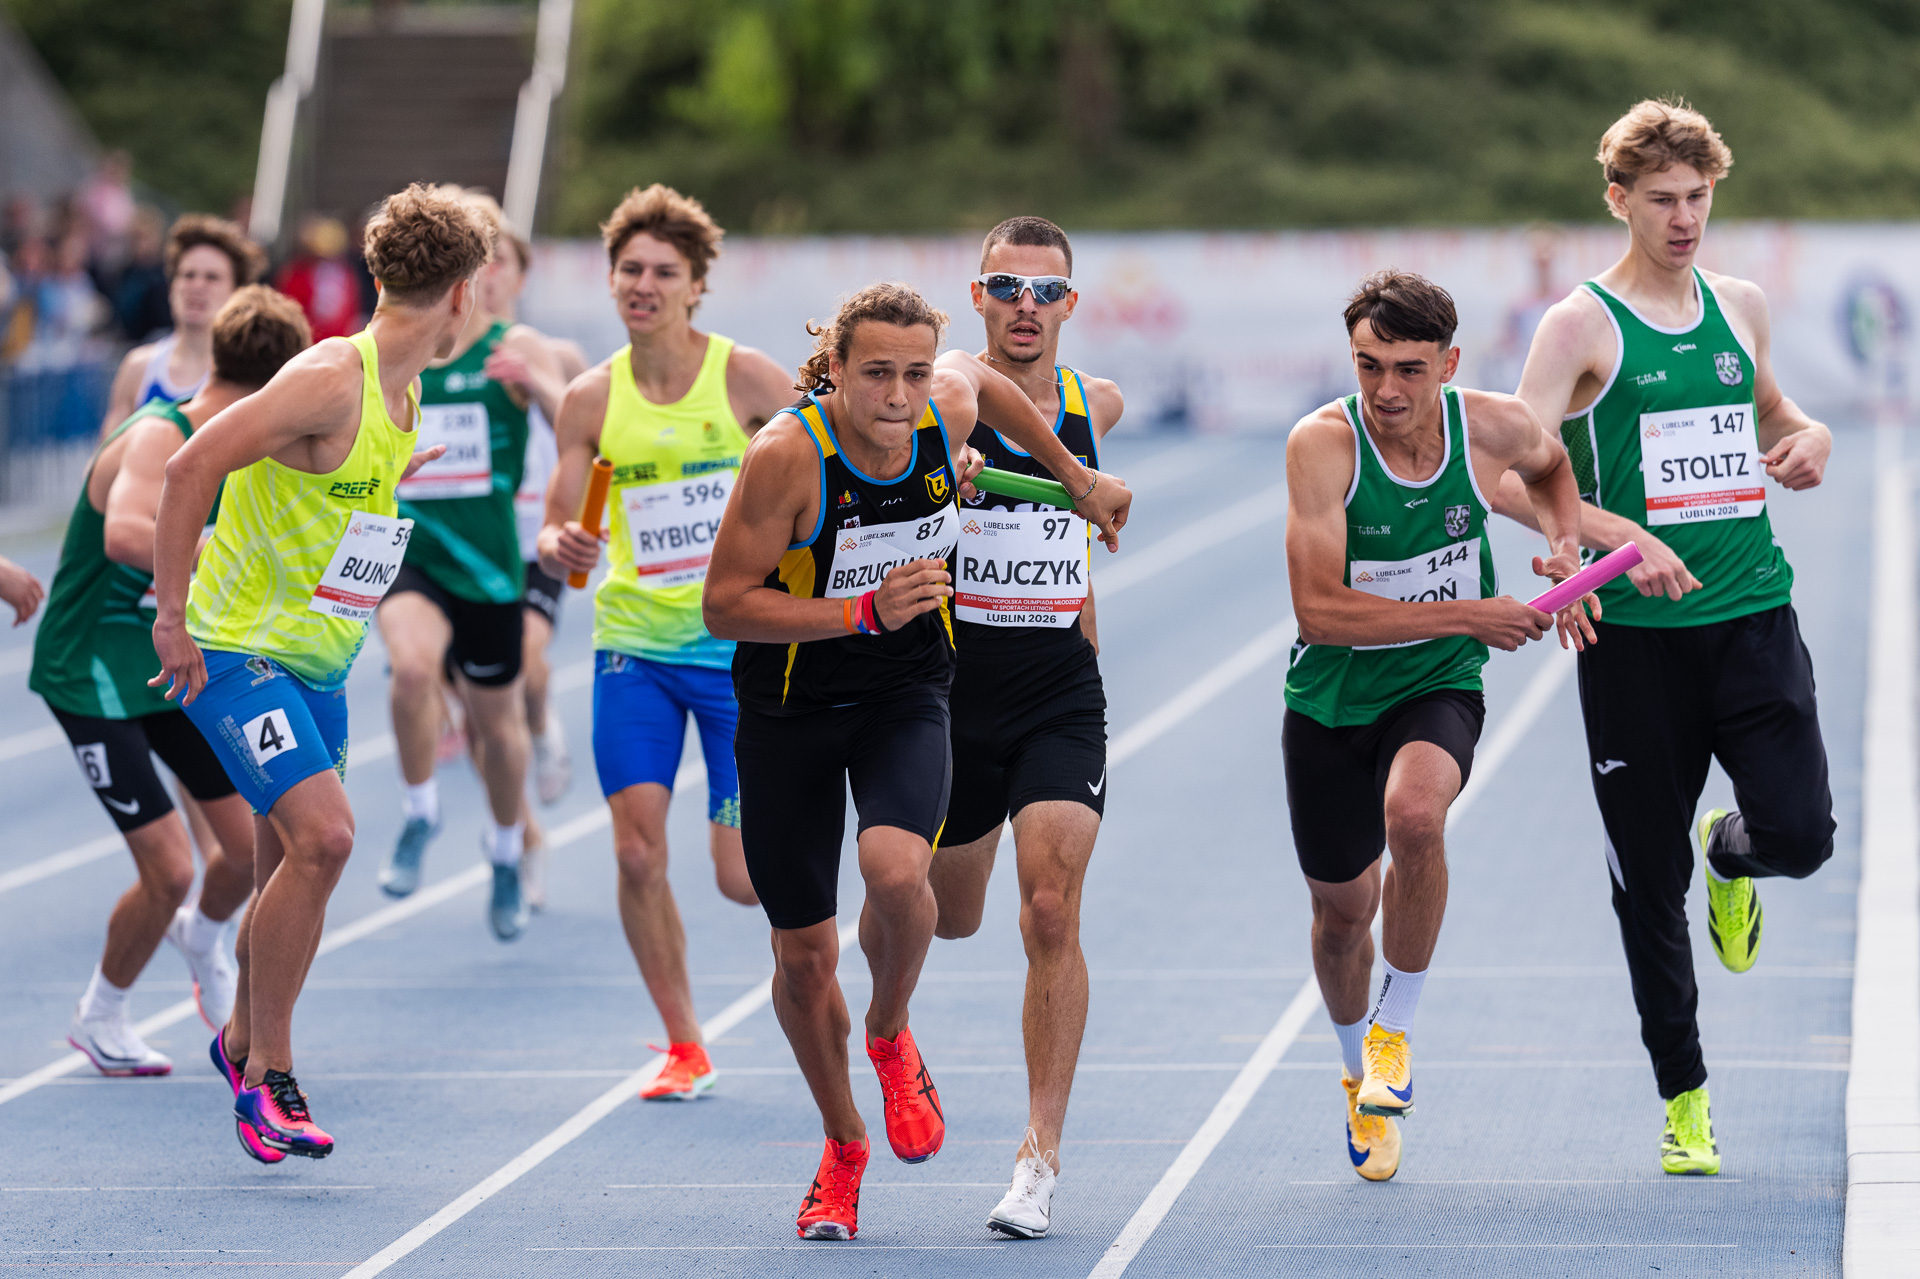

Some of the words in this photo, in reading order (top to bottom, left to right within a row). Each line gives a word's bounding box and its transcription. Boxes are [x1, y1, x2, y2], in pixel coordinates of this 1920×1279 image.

[1662, 420, 1695, 429] LUBELSKIE
[1710, 412, 1745, 435] 147
[1661, 452, 1749, 483] STOLTZ
[683, 481, 725, 507] 596
[1680, 508, 1716, 519] LUBLIN
[1717, 505, 1739, 515] 2026
[859, 531, 896, 541] LUBELSKIE
[916, 516, 945, 540] 87
[984, 521, 1021, 530] LUBELSKIE
[1042, 517, 1070, 540] 97
[339, 556, 397, 585] BUJNO
[963, 556, 1082, 585] RAJCZYK
[1426, 545, 1469, 575] 144
[1375, 567, 1412, 577] LUBELSKIE
[977, 596, 1022, 605] OGÓLNOPOLSKA
[986, 613, 1026, 622] LUBLIN
[1028, 614, 1057, 623] 2026
[258, 716, 285, 752] 4
[83, 751, 101, 782] 6
